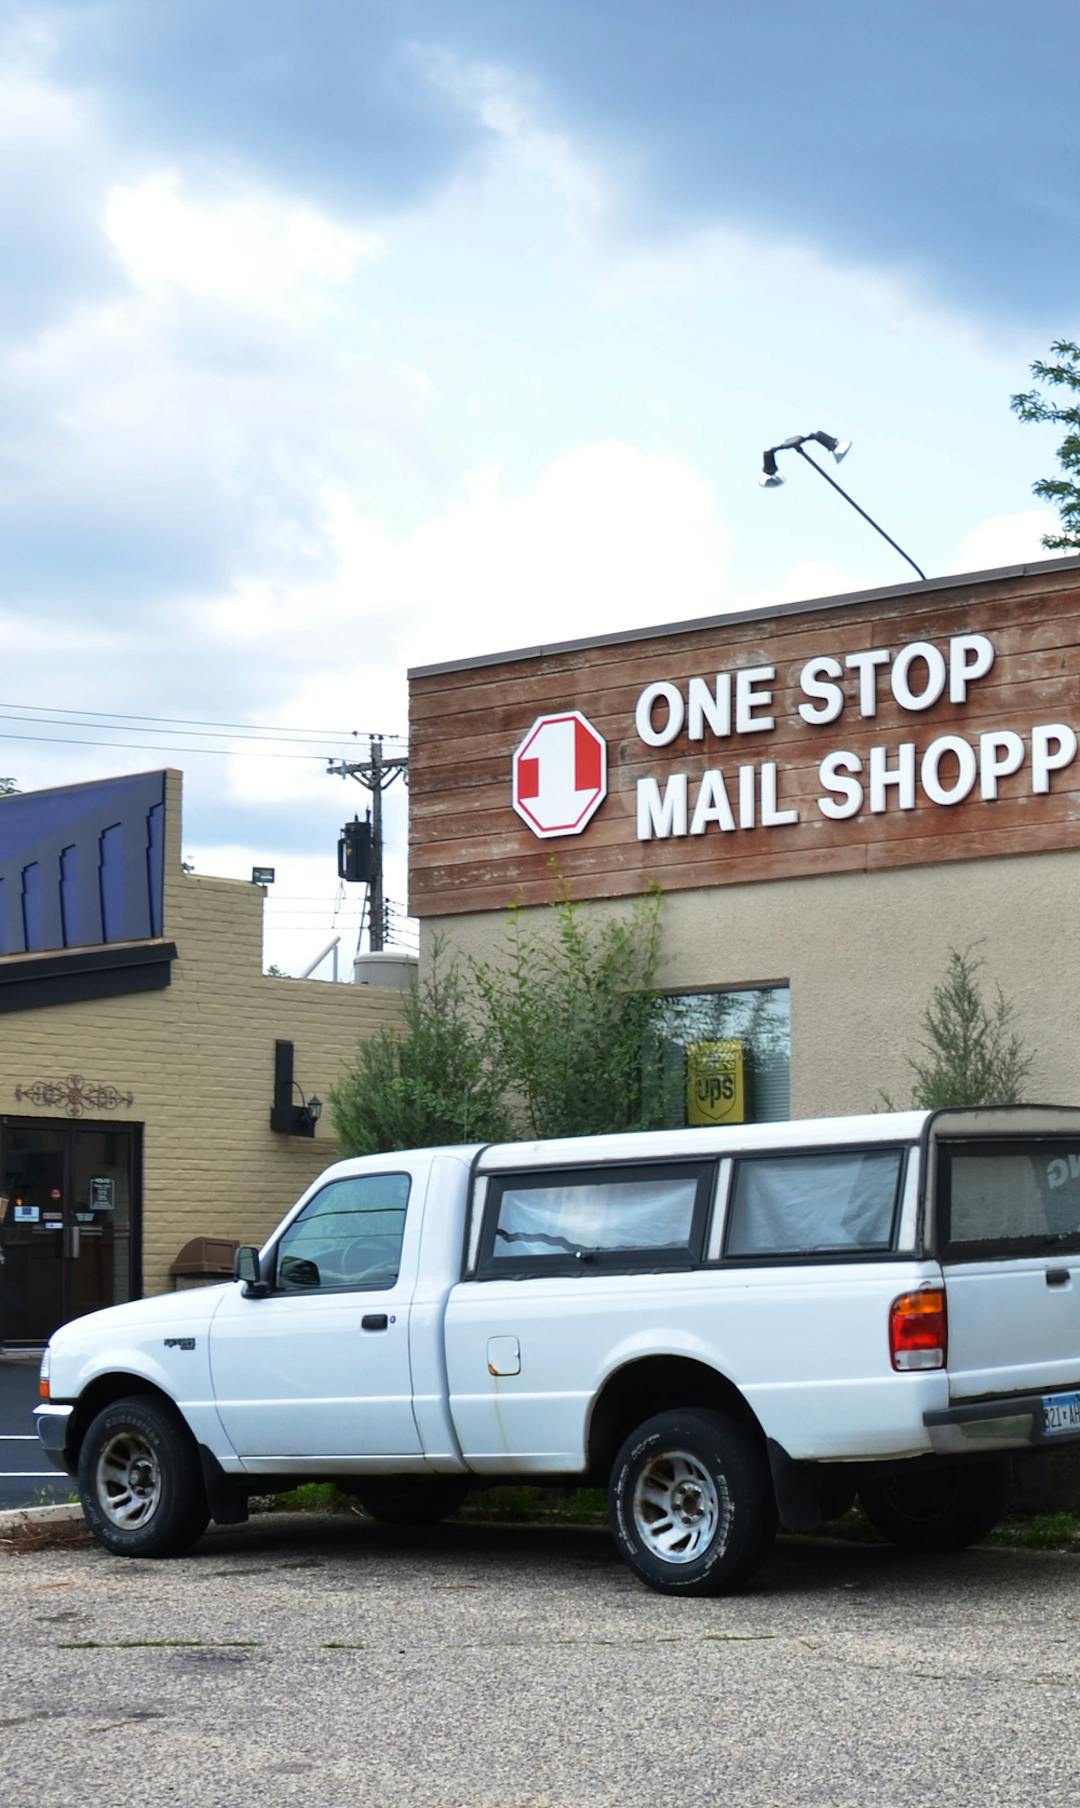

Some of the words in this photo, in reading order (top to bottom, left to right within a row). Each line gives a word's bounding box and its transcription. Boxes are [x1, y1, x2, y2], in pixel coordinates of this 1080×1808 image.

[635, 666, 776, 748] ONE
[799, 634, 995, 725] STOP
[637, 762, 798, 841] MAIL
